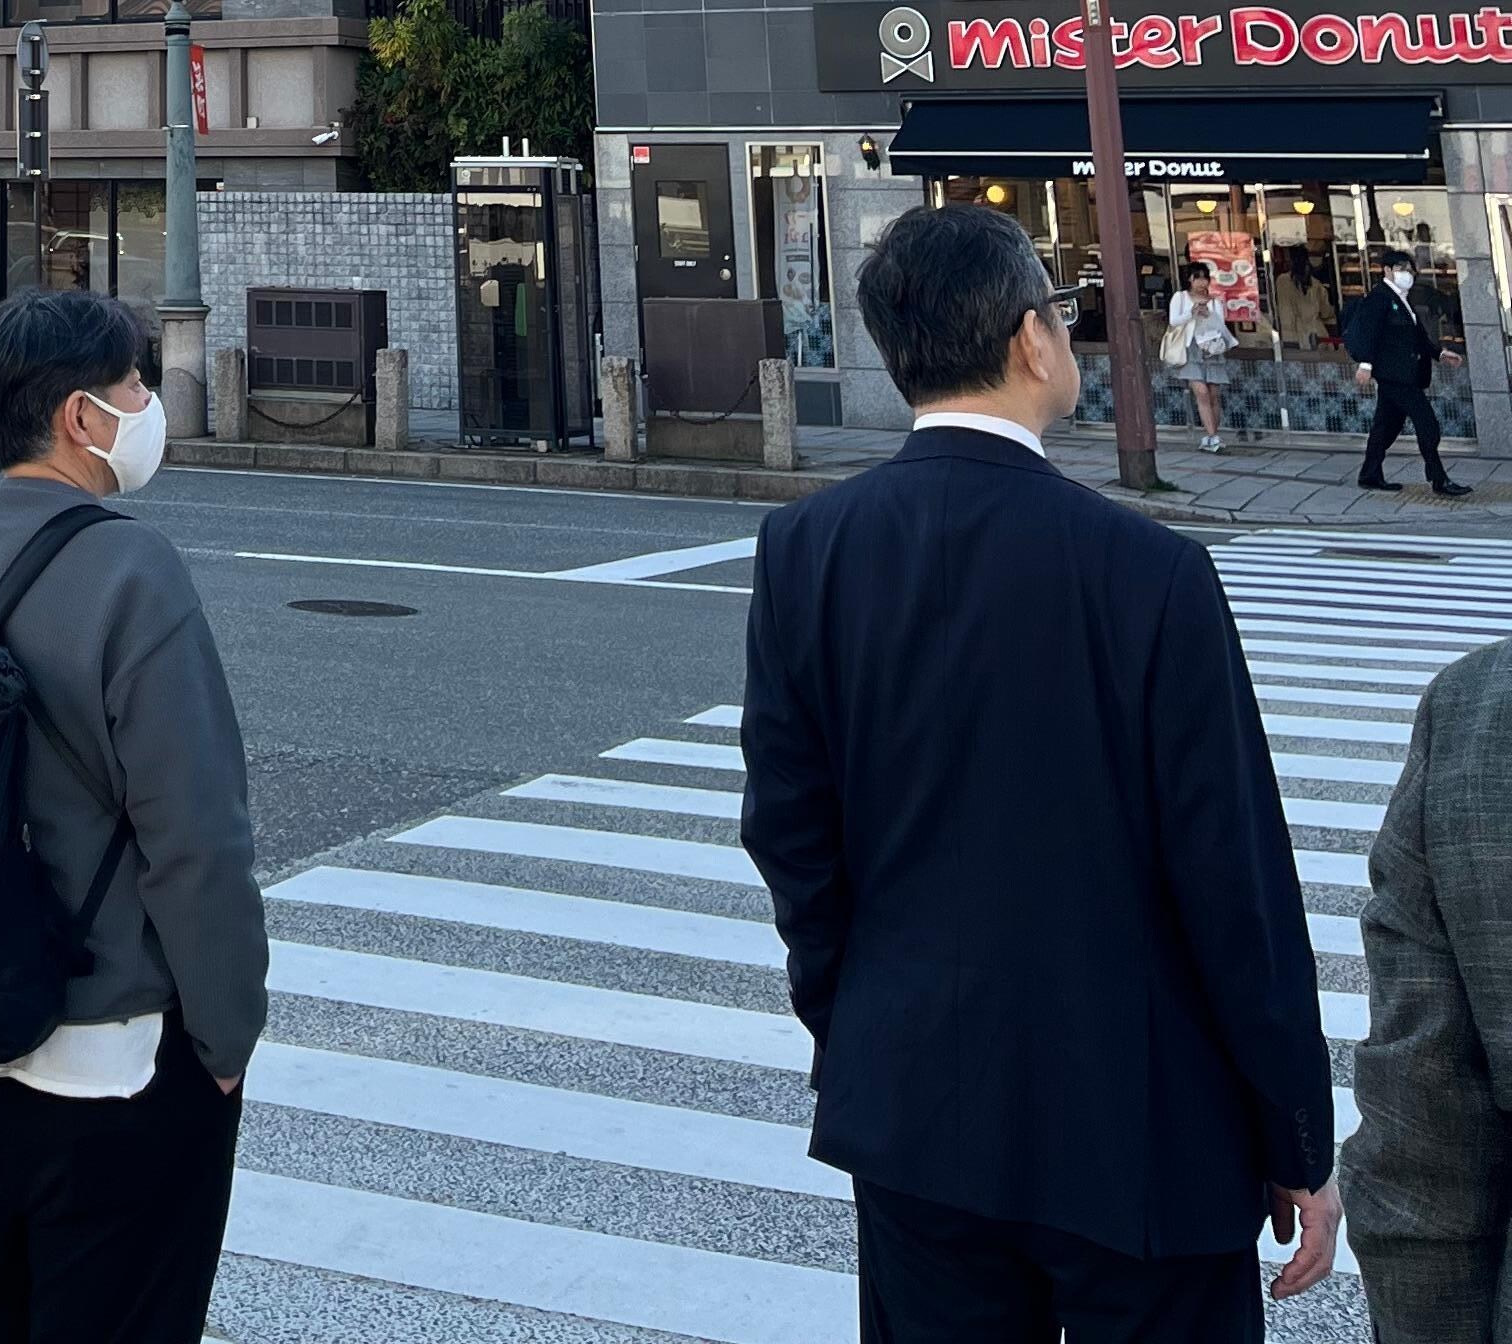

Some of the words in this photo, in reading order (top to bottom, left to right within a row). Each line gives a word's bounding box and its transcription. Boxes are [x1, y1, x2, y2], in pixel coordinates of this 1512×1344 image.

[1228, 6, 1512, 66] Donut
[1072, 160, 1146, 176] mer
[1148, 160, 1225, 177] Donut
